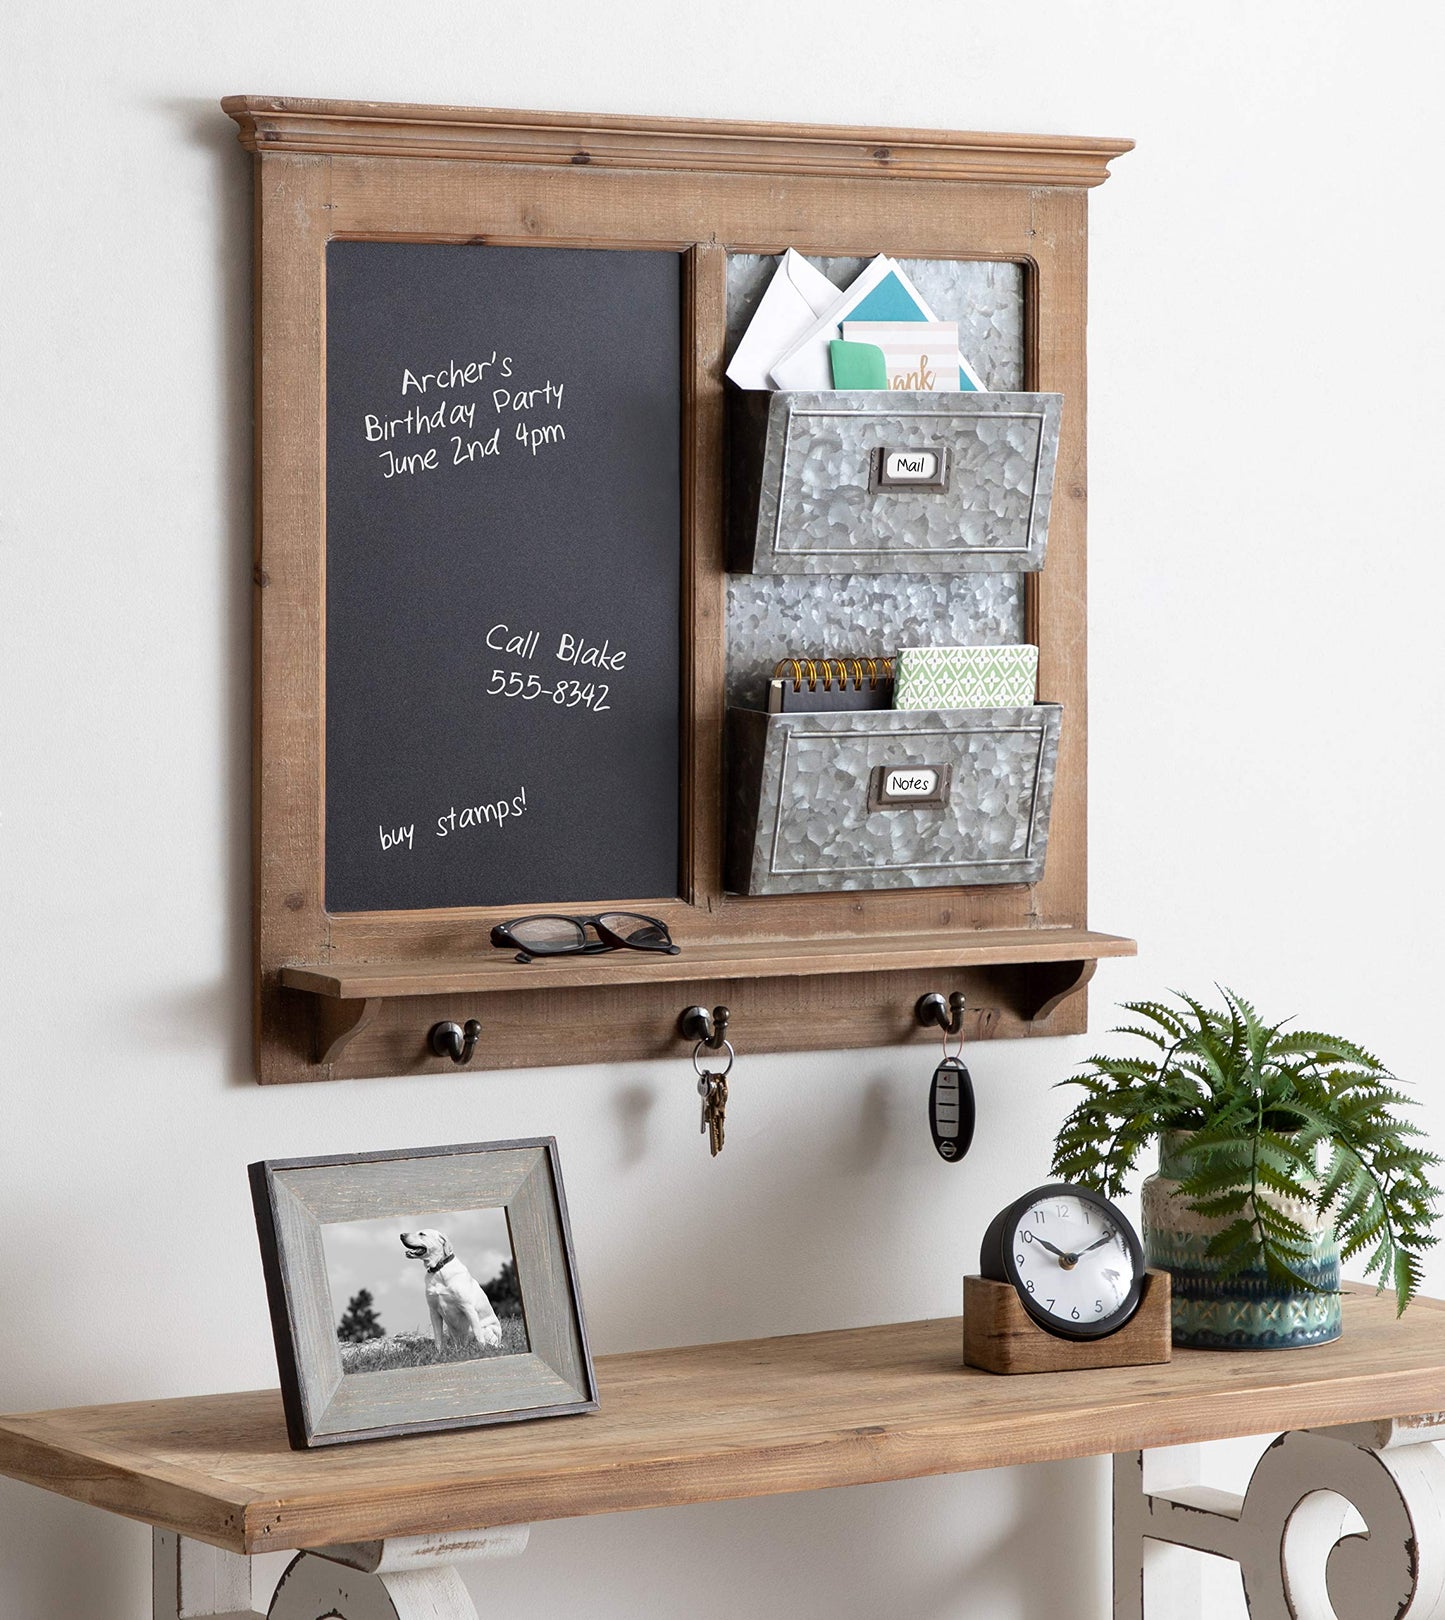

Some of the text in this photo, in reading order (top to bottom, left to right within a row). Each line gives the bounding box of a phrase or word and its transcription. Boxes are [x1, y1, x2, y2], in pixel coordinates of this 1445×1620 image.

[401, 350, 513, 395] Archer's
[887, 354, 937, 390] ank
[364, 380, 564, 442] Birthday Party
[378, 422, 566, 479] June 2nd 4pm
[896, 457, 925, 473] Mail
[486, 624, 627, 671] Call Blake
[486, 669, 611, 712] 555-8342
[892, 776, 929, 791] Notes
[379, 786, 528, 851] buy stamps!
[1033, 1211, 1046, 1224] 11
[1055, 1204, 1070, 1218] 12
[1084, 1212, 1090, 1224] 1
[1019, 1230, 1033, 1244] 10
[1016, 1254, 1025, 1267] 9
[1026, 1280, 1035, 1294] 8
[1046, 1299, 1056, 1312] 7
[1094, 1300, 1103, 1313] 5
[1071, 1306, 1080, 1320] 6
